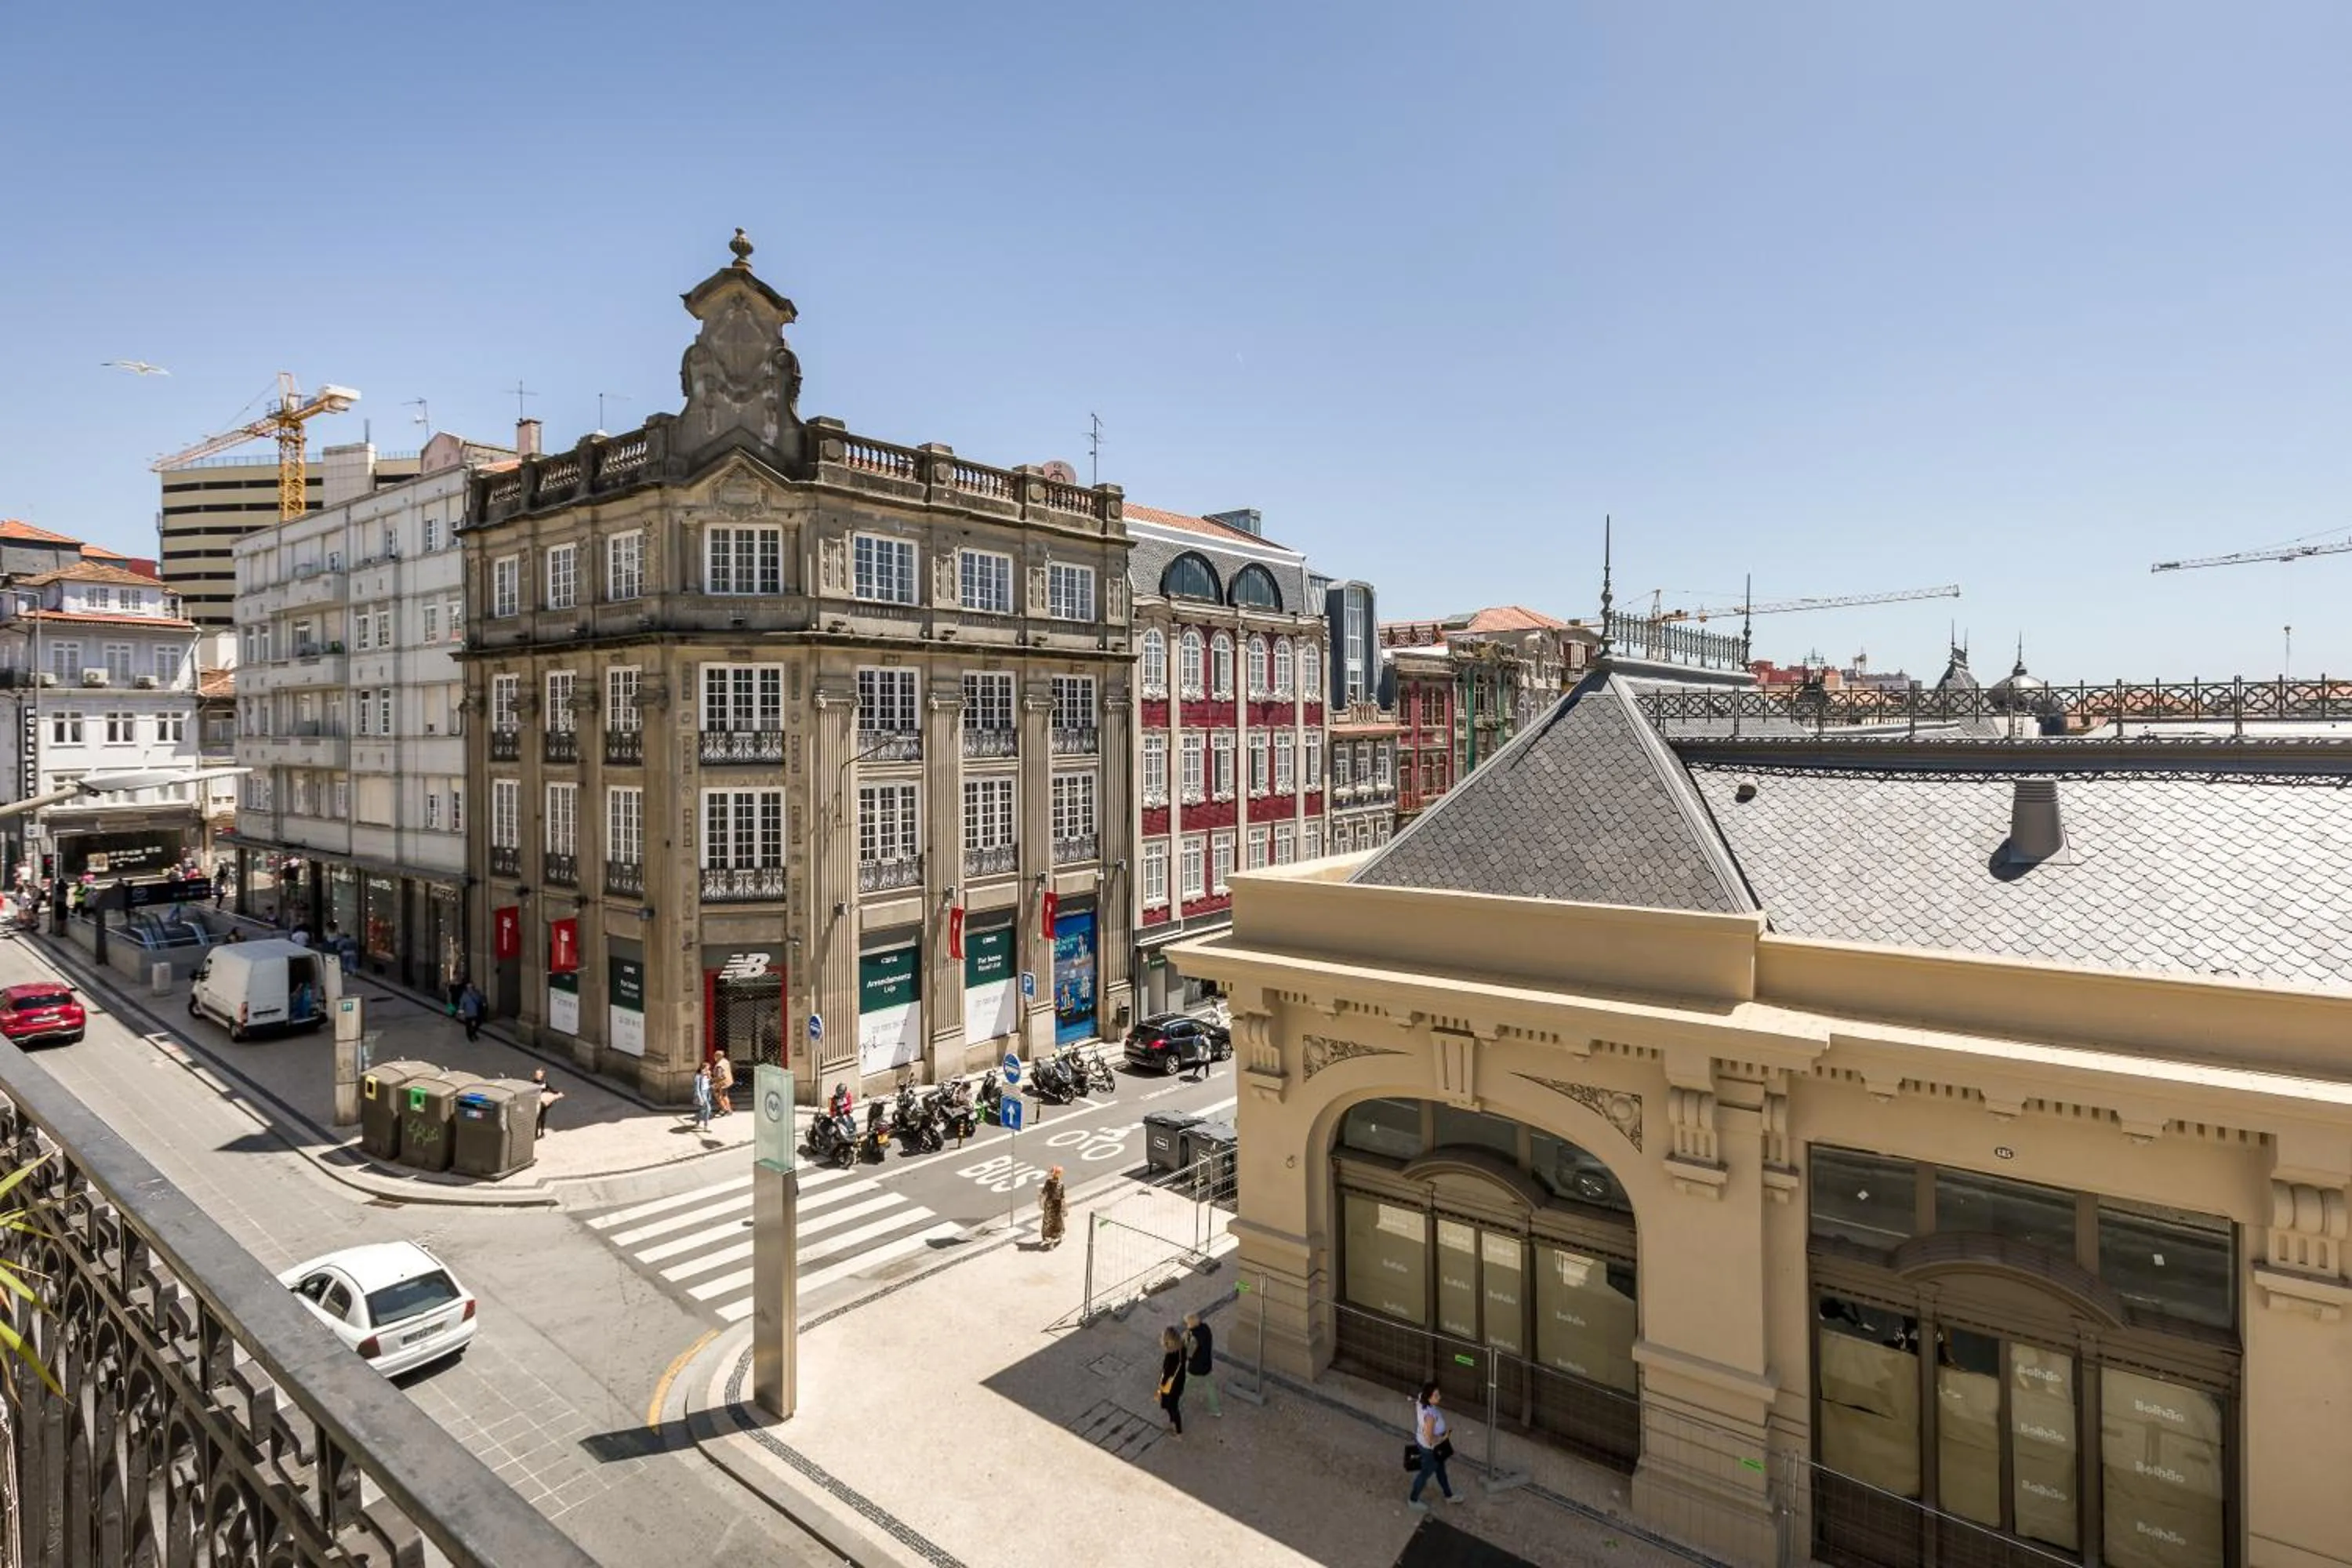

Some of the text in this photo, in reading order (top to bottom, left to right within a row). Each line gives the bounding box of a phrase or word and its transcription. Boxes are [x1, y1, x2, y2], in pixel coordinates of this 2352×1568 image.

[1024, 976, 1032, 992] P
[955, 1155, 1048, 1192] BUS
[2135, 1399, 2185, 1423] Bolhão
[2020, 1422, 2067, 1443] Bolhão
[2136, 1461, 2186, 1483] Bolhão
[2022, 1479, 2068, 1501] Bolhão
[2136, 1522, 2187, 1545] Bolhão
